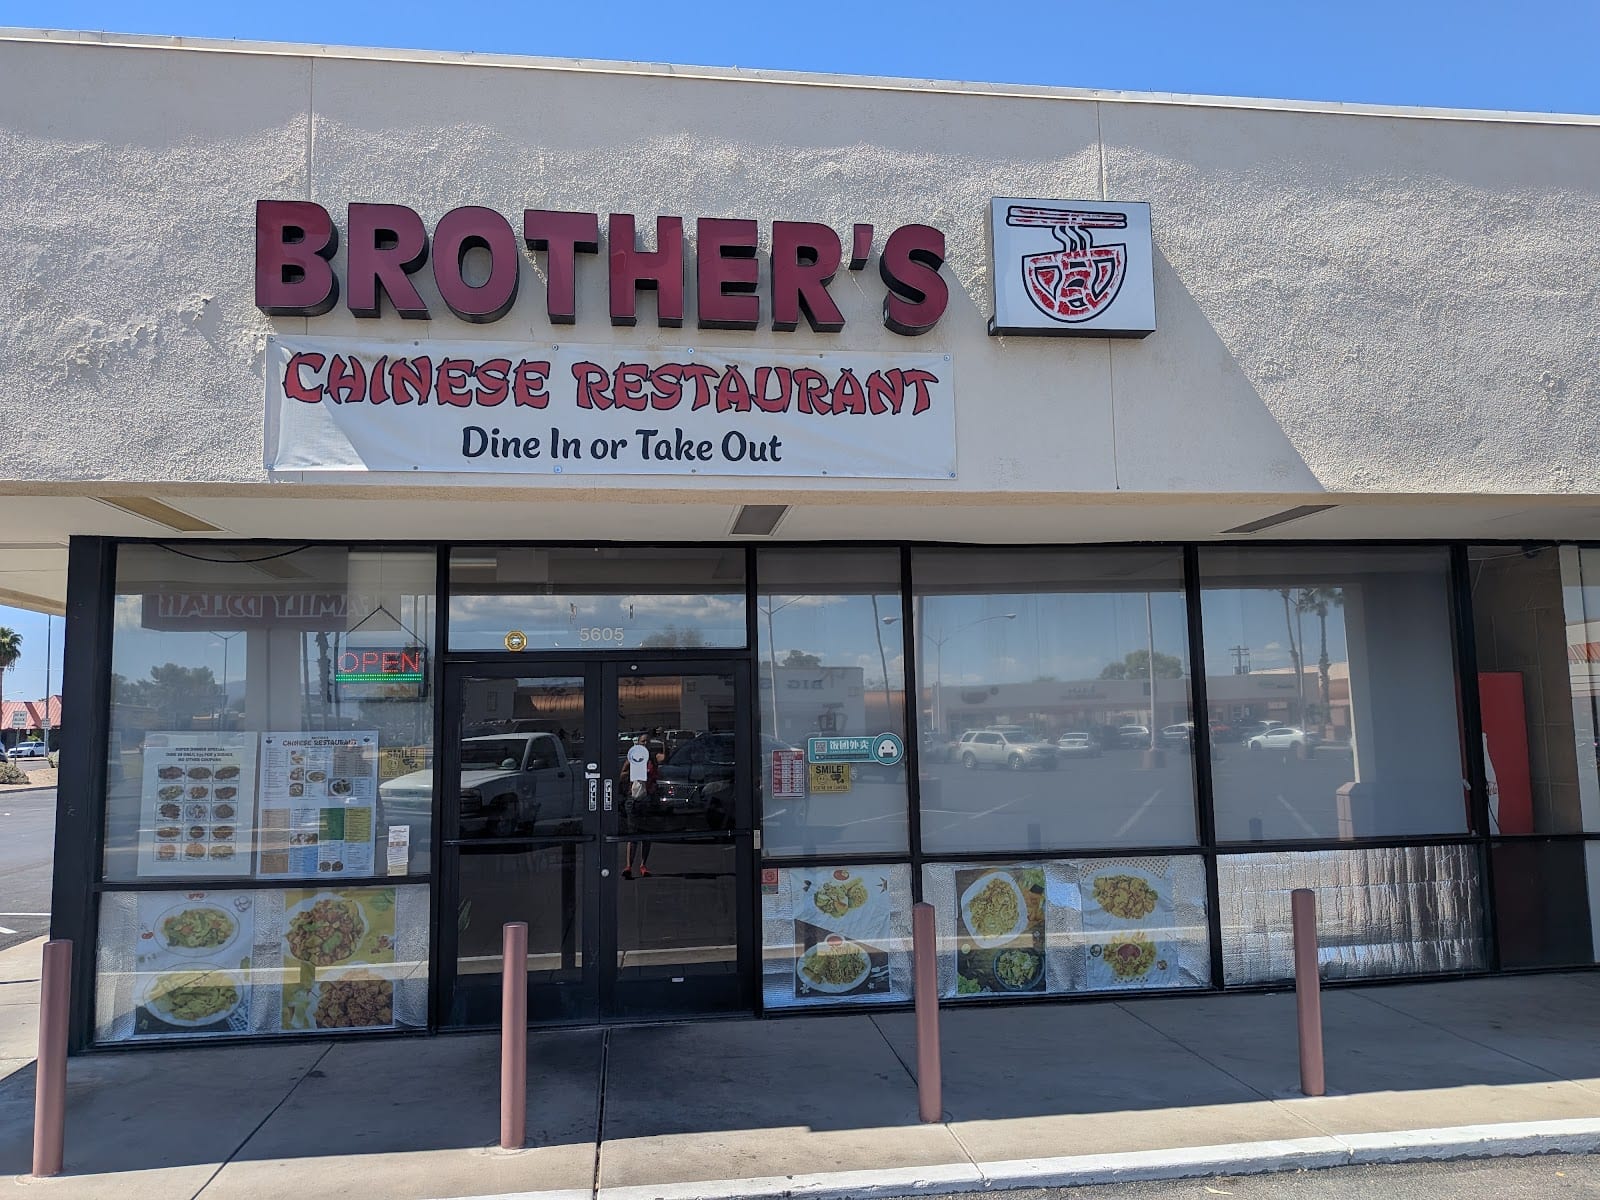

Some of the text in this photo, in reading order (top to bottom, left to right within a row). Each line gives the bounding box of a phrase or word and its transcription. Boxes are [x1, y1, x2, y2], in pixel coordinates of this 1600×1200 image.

[255, 200, 949, 336] BROTHER'S
[282, 352, 940, 415] CHINESE RESTAURANT
[462, 425, 782, 462] Dine In or Take Out
[580, 627, 624, 641] 5605
[338, 651, 420, 673] OPEN
[816, 765, 844, 774] SMILE!
